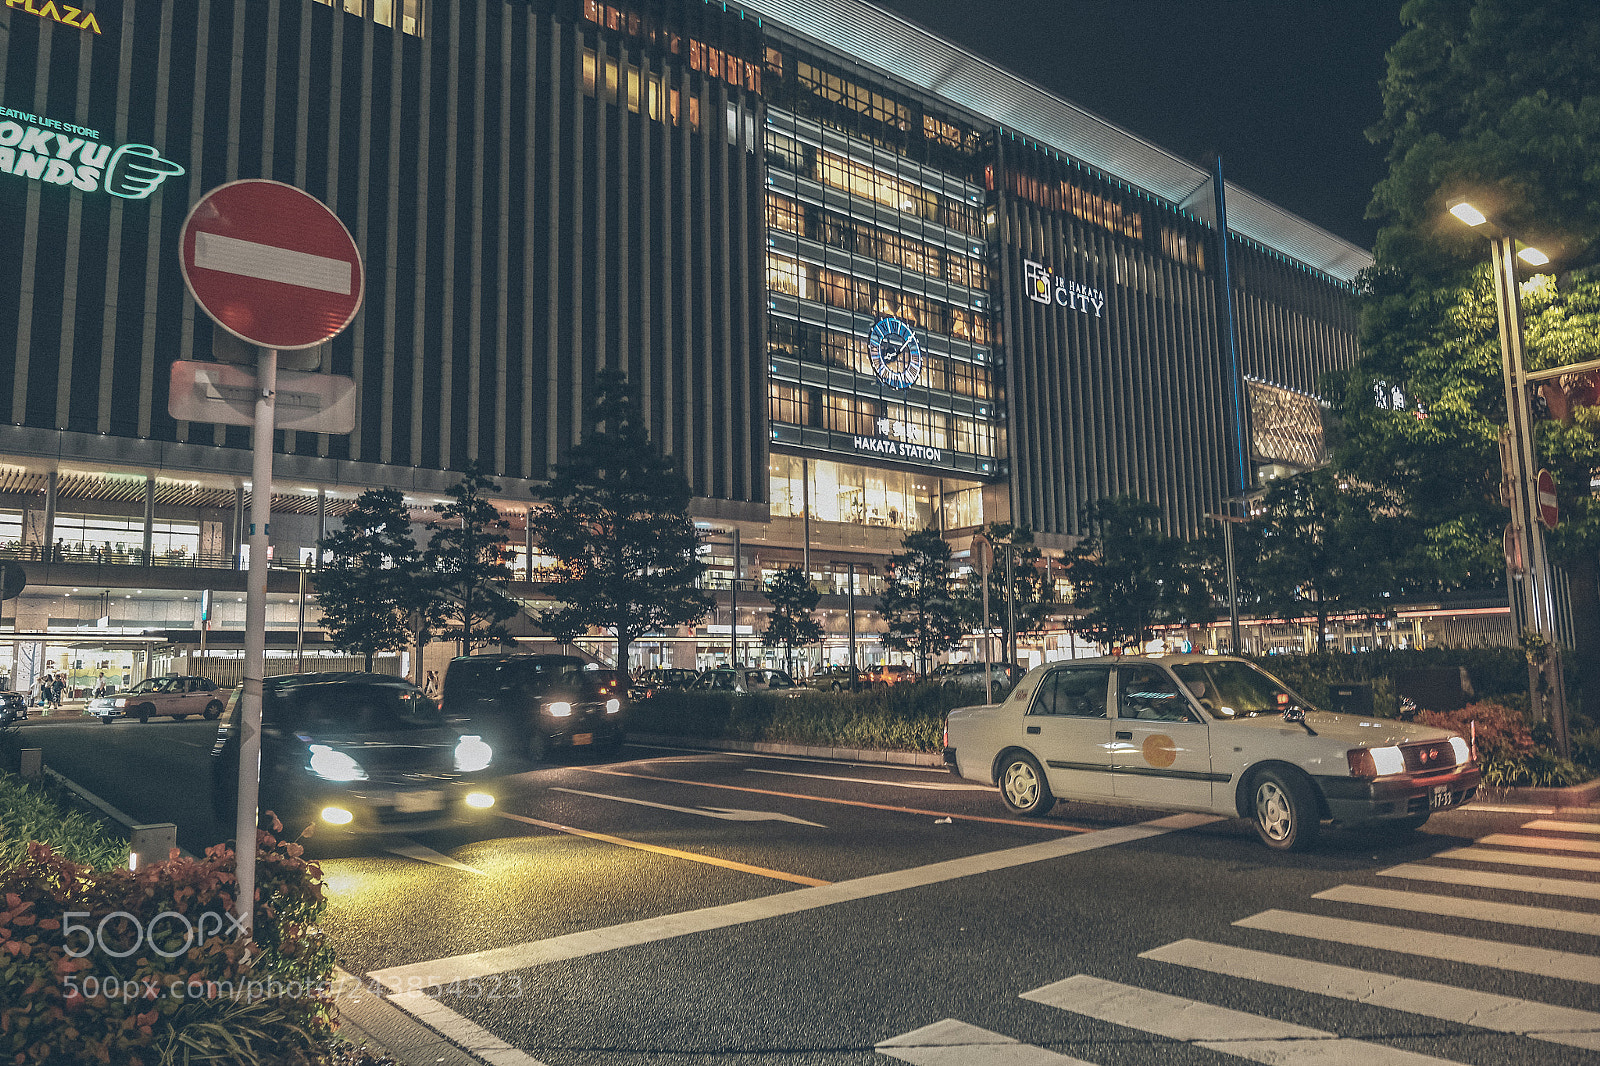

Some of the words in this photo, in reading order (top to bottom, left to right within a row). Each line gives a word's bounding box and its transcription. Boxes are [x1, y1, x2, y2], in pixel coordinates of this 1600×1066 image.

[0, 106, 37, 124] EATIVE
[38, 116, 62, 130] LIFE
[63, 123, 100, 140] STORE
[0, 120, 112, 170] OKYU
[0, 145, 101, 192] ANDS
[1055, 287, 1104, 318] CITY
[1069, 280, 1104, 301] HAKATA
[854, 435, 897, 455] HAKATA
[900, 443, 941, 462] STATION
